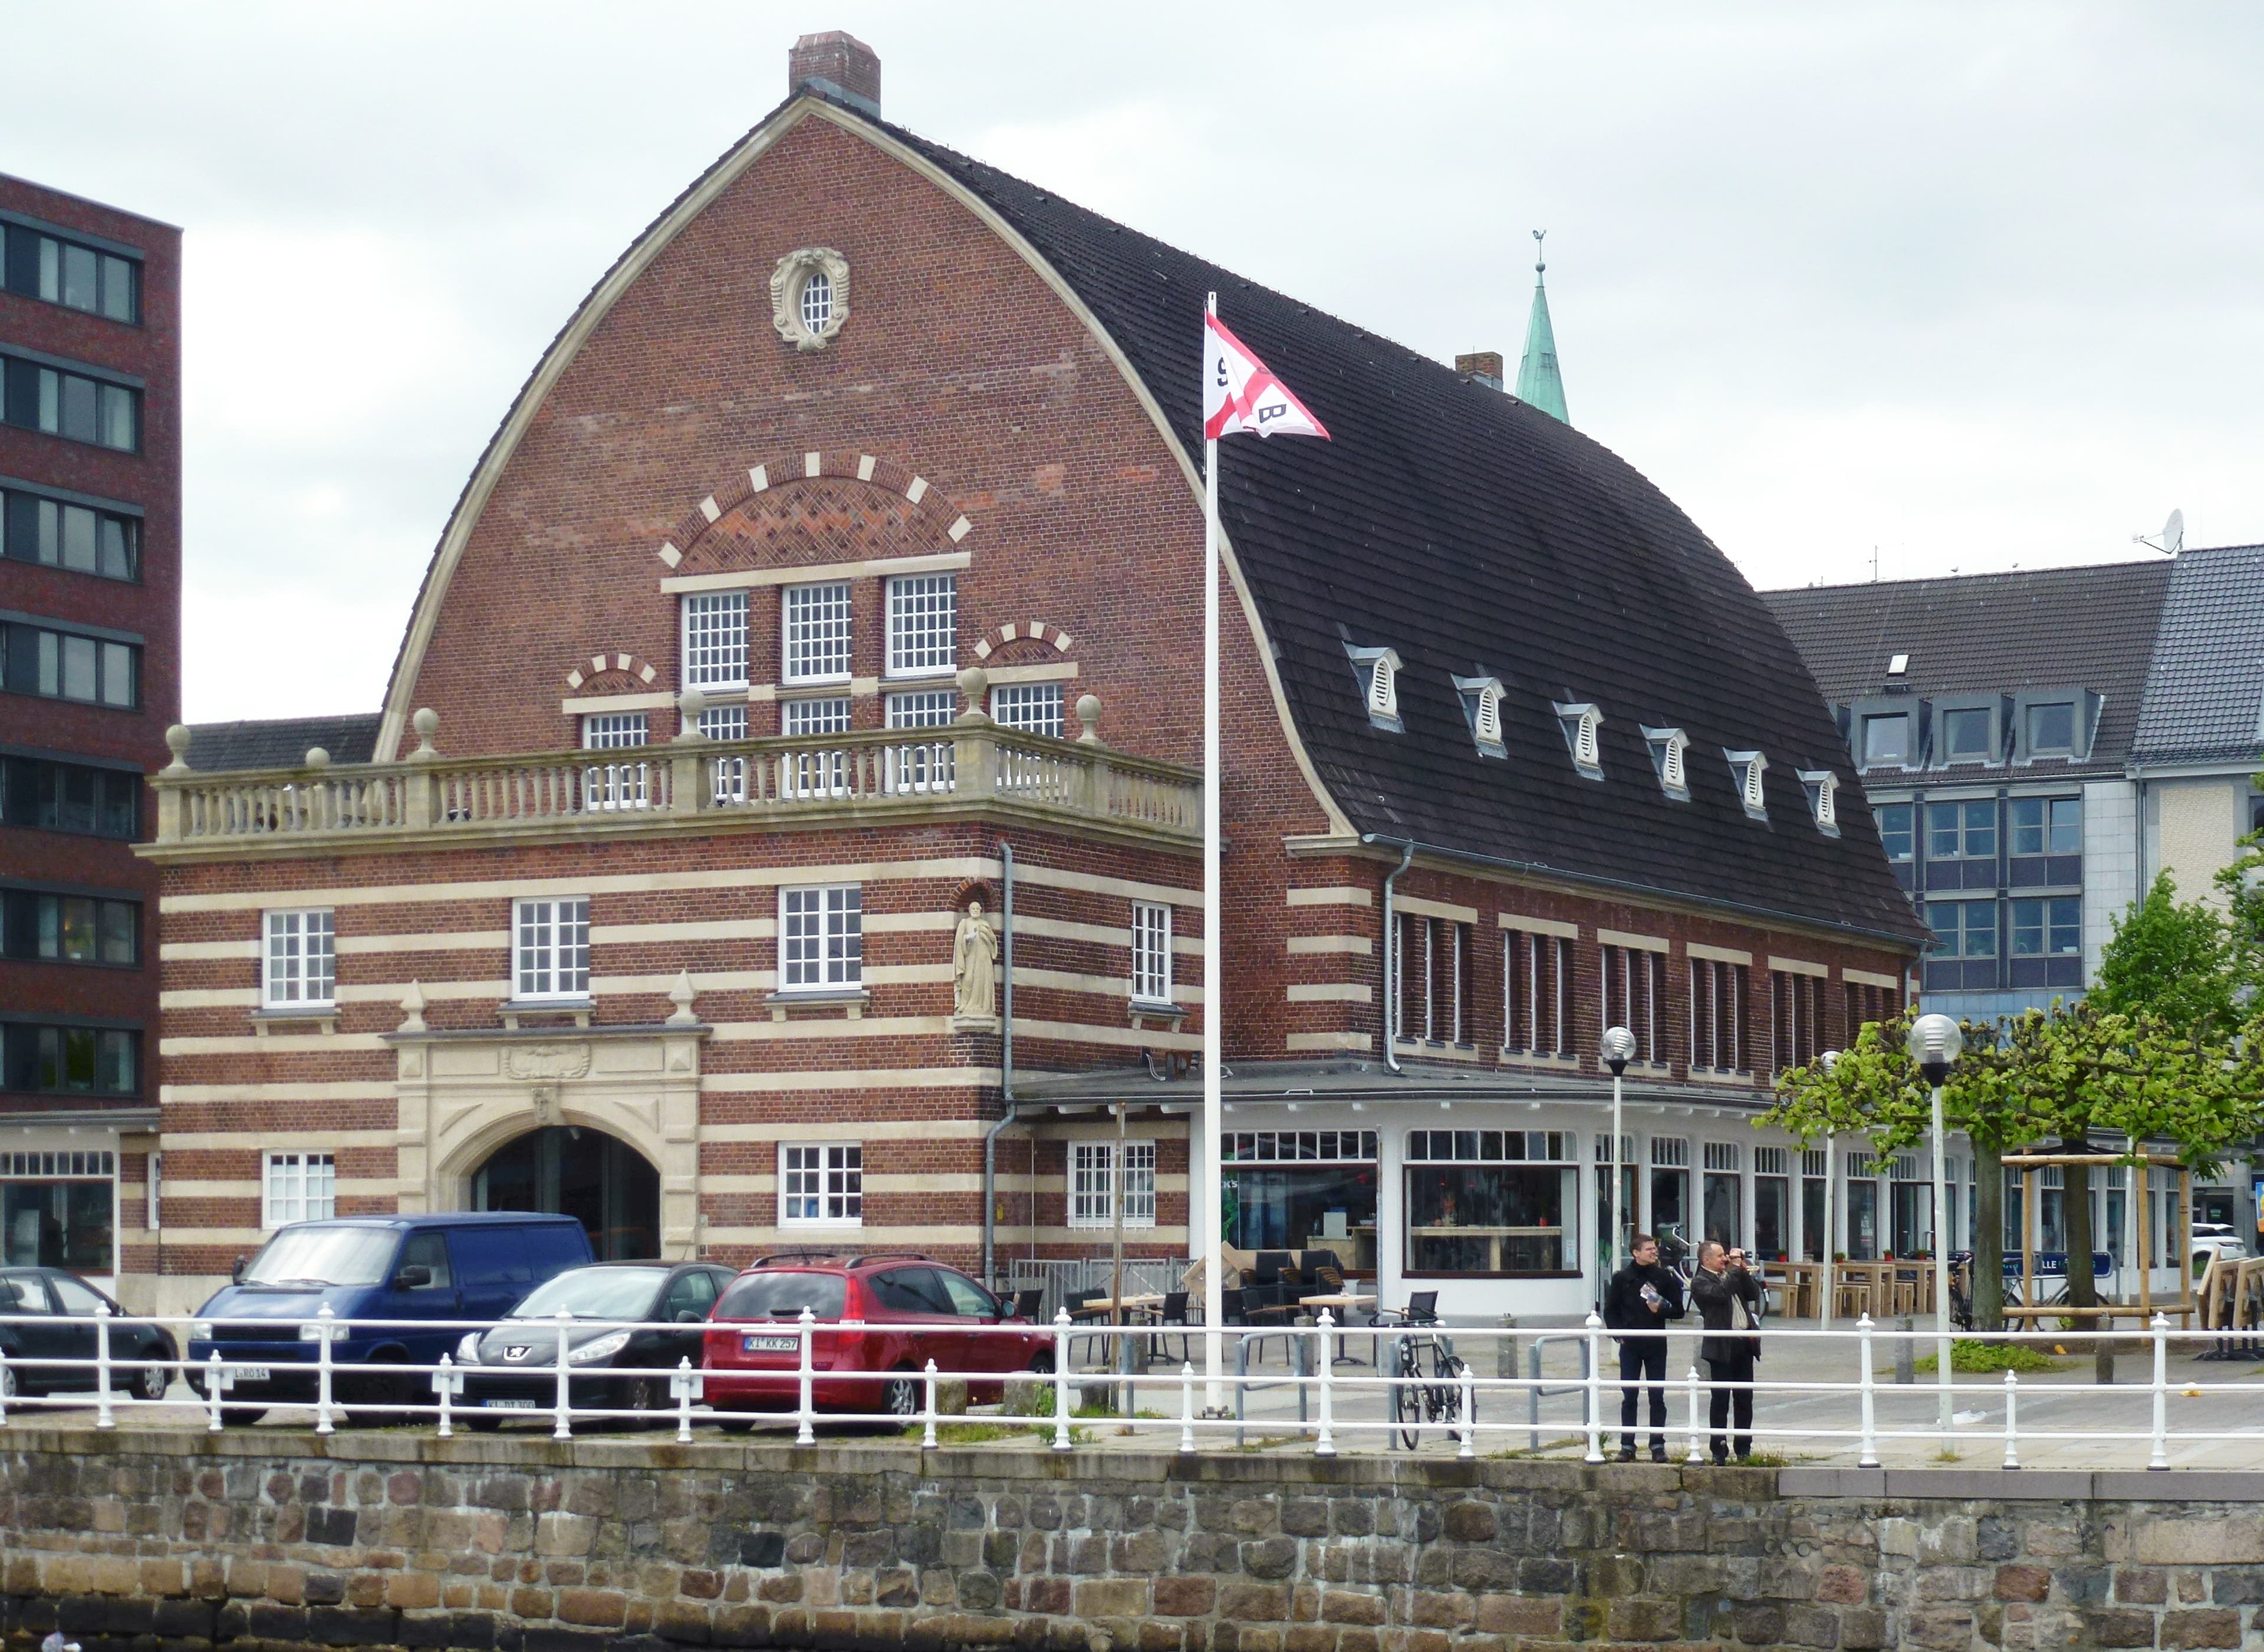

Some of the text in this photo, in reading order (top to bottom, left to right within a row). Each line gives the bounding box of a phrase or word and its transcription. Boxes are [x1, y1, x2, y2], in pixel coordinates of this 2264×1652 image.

[1258, 403, 1287, 423] B
[1221, 1179, 1238, 1188] K'S
[766, 1338, 778, 1348] KK
[780, 1338, 797, 1348] 257
